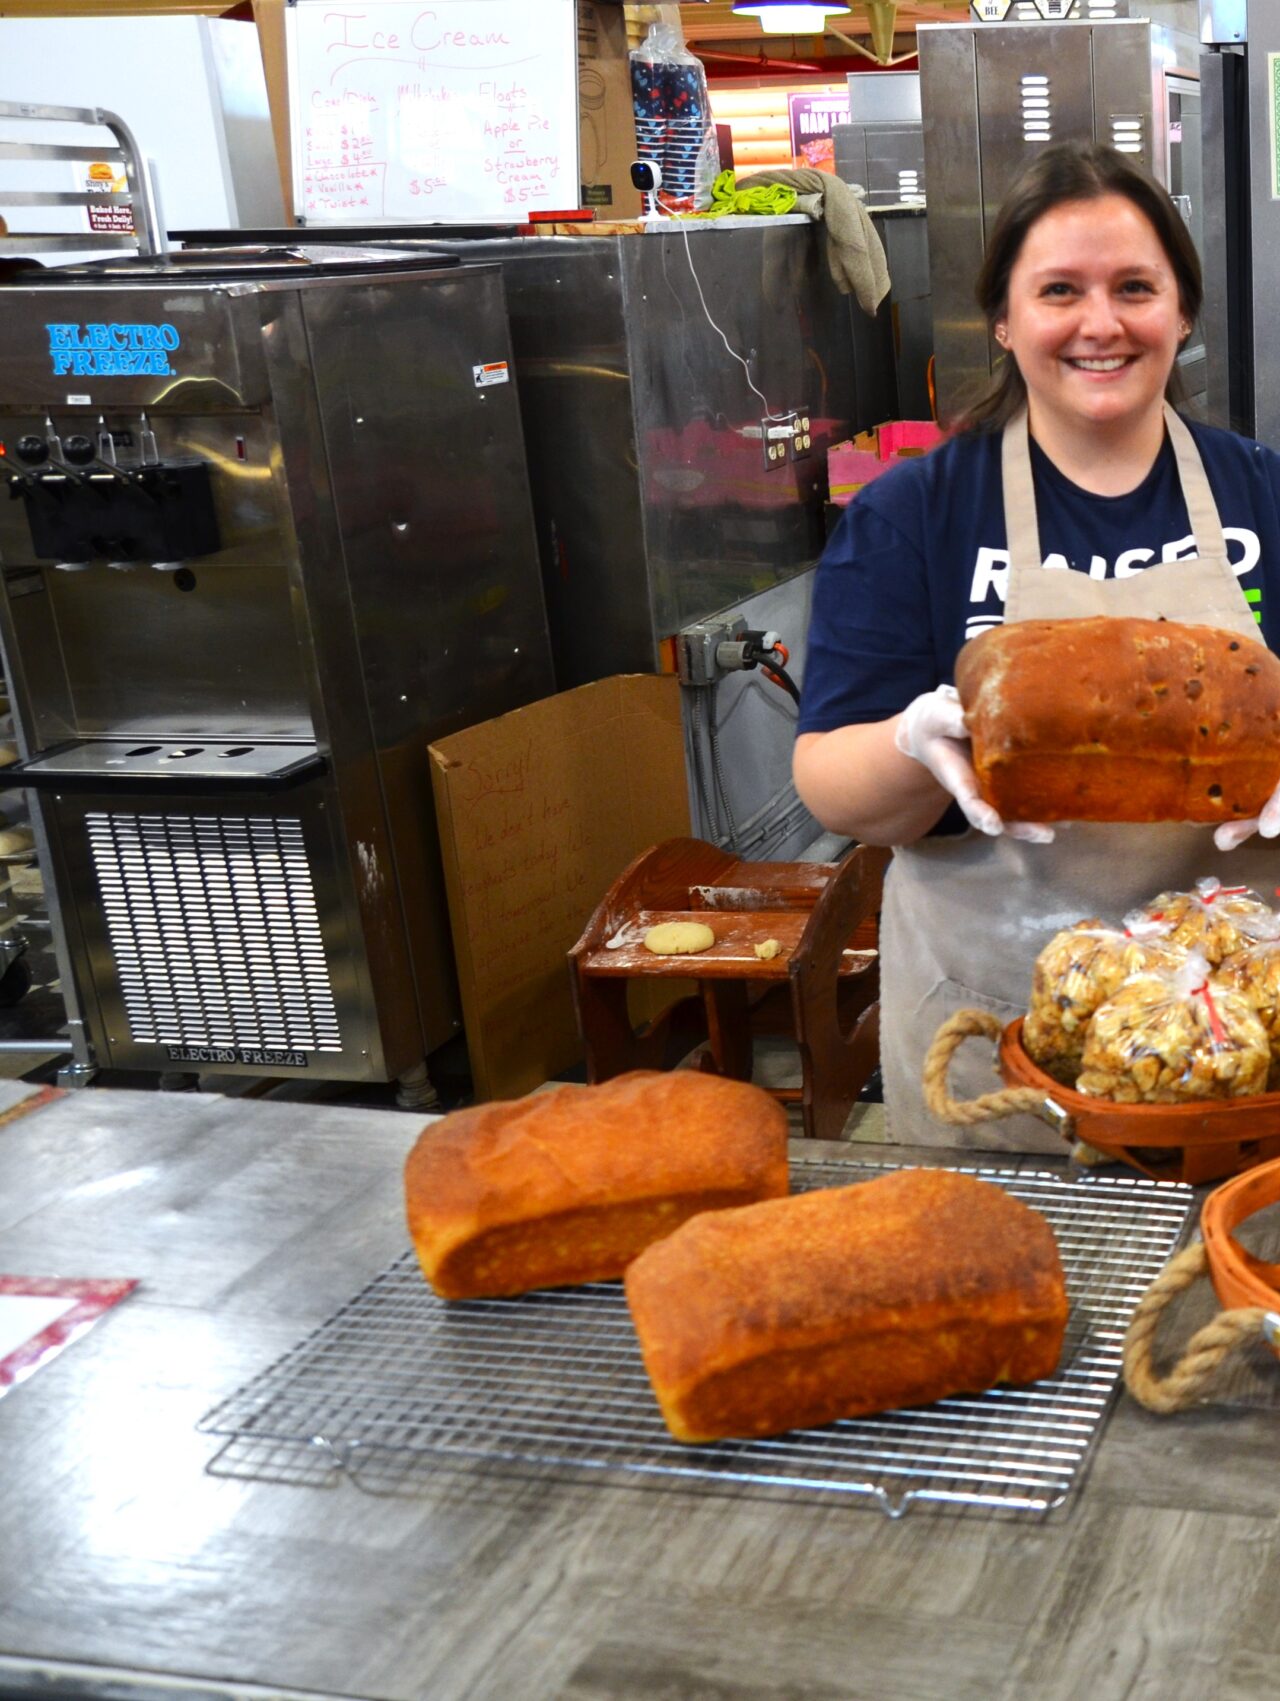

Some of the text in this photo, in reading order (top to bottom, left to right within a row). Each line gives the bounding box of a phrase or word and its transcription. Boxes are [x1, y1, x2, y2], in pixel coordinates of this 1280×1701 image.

[323, 11, 511, 53] Ice Cream
[46, 323, 180, 351] ELECTRO
[169, 1047, 307, 1067] ELECTRO FREEZE
